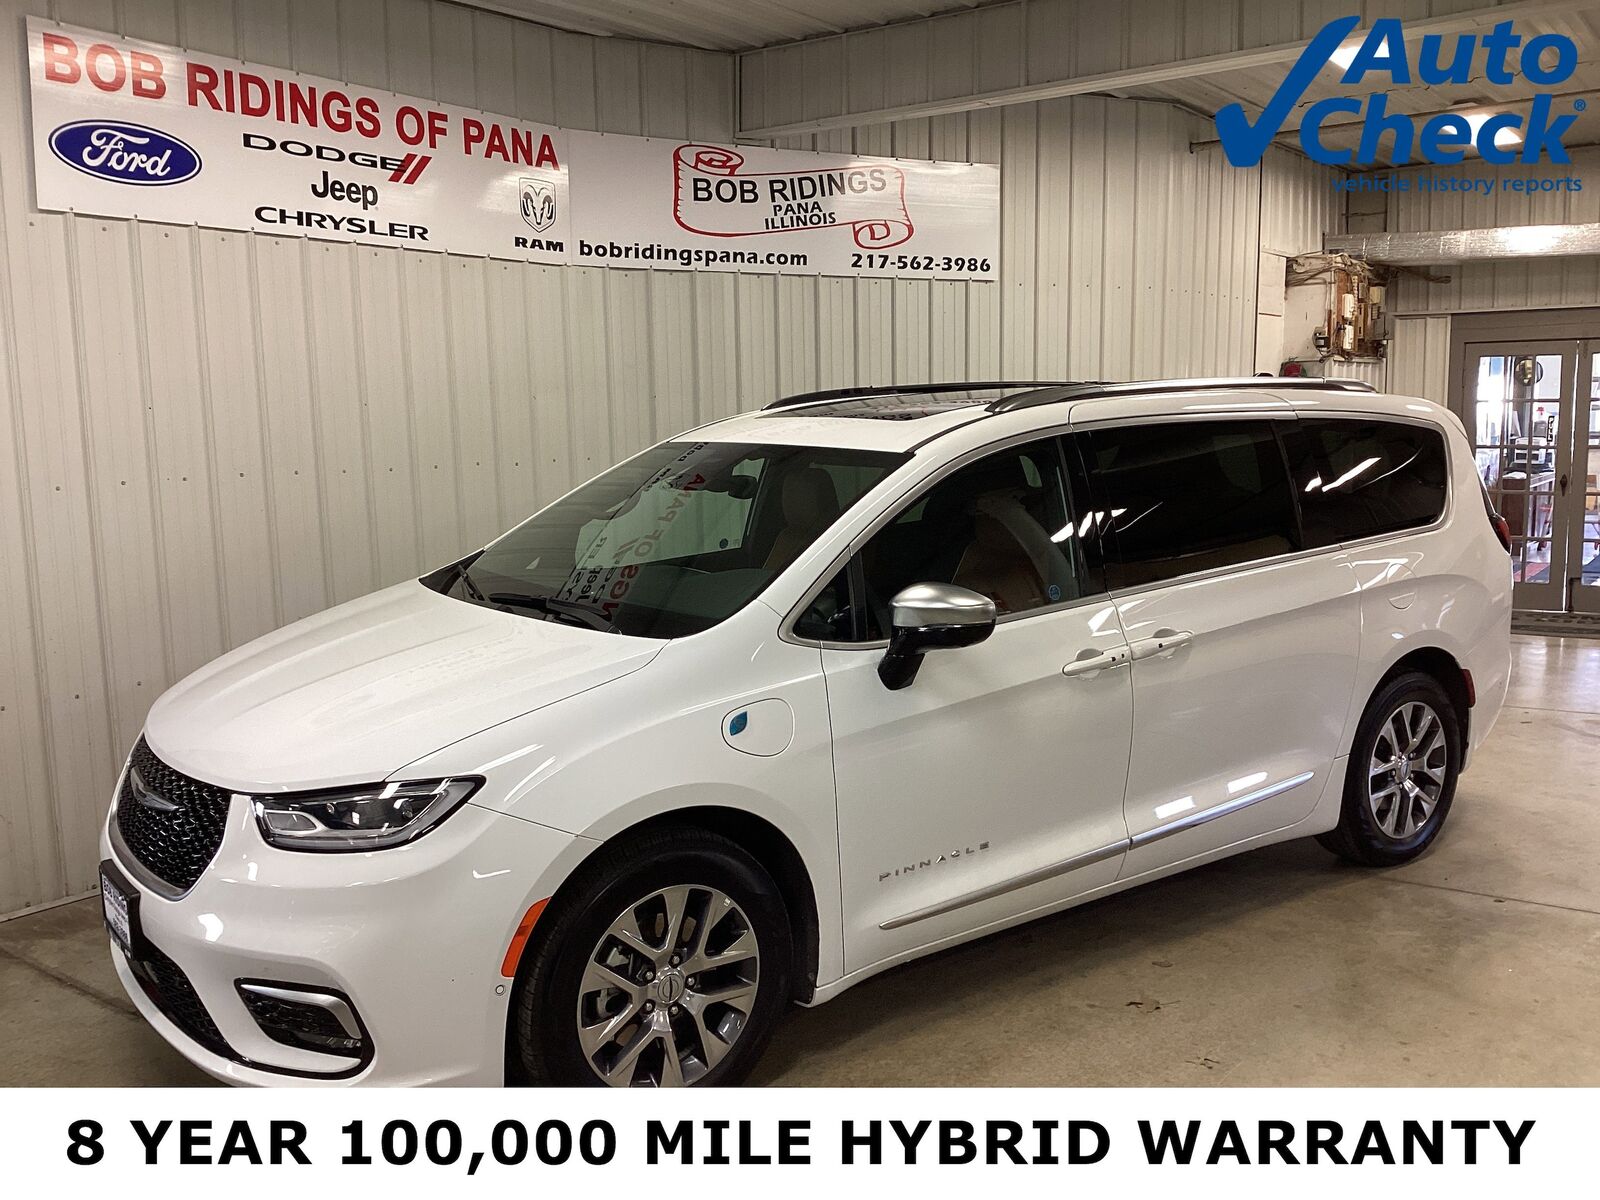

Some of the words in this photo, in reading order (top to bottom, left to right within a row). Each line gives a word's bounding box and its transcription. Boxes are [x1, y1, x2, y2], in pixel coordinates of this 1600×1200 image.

[42, 32, 167, 100] BOB
[186, 62, 382, 139] RIDINGS
[395, 105, 449, 150] OF
[462, 117, 561, 171] PANA
[82, 128, 171, 177] Ford
[242, 132, 405, 171] DODGE
[311, 171, 378, 210] Jeep
[692, 177, 758, 203] BOB
[769, 168, 887, 202] RIDINGS
[254, 205, 429, 242] CHRYSLER
[764, 212, 837, 230] ILLINOIS
[773, 201, 823, 217] PANA
[514, 236, 564, 253] RAM
[579, 240, 808, 267] bobridingspana.com
[851, 253, 991, 273] 217-562-3986
[879, 841, 990, 882] PINNACLE
